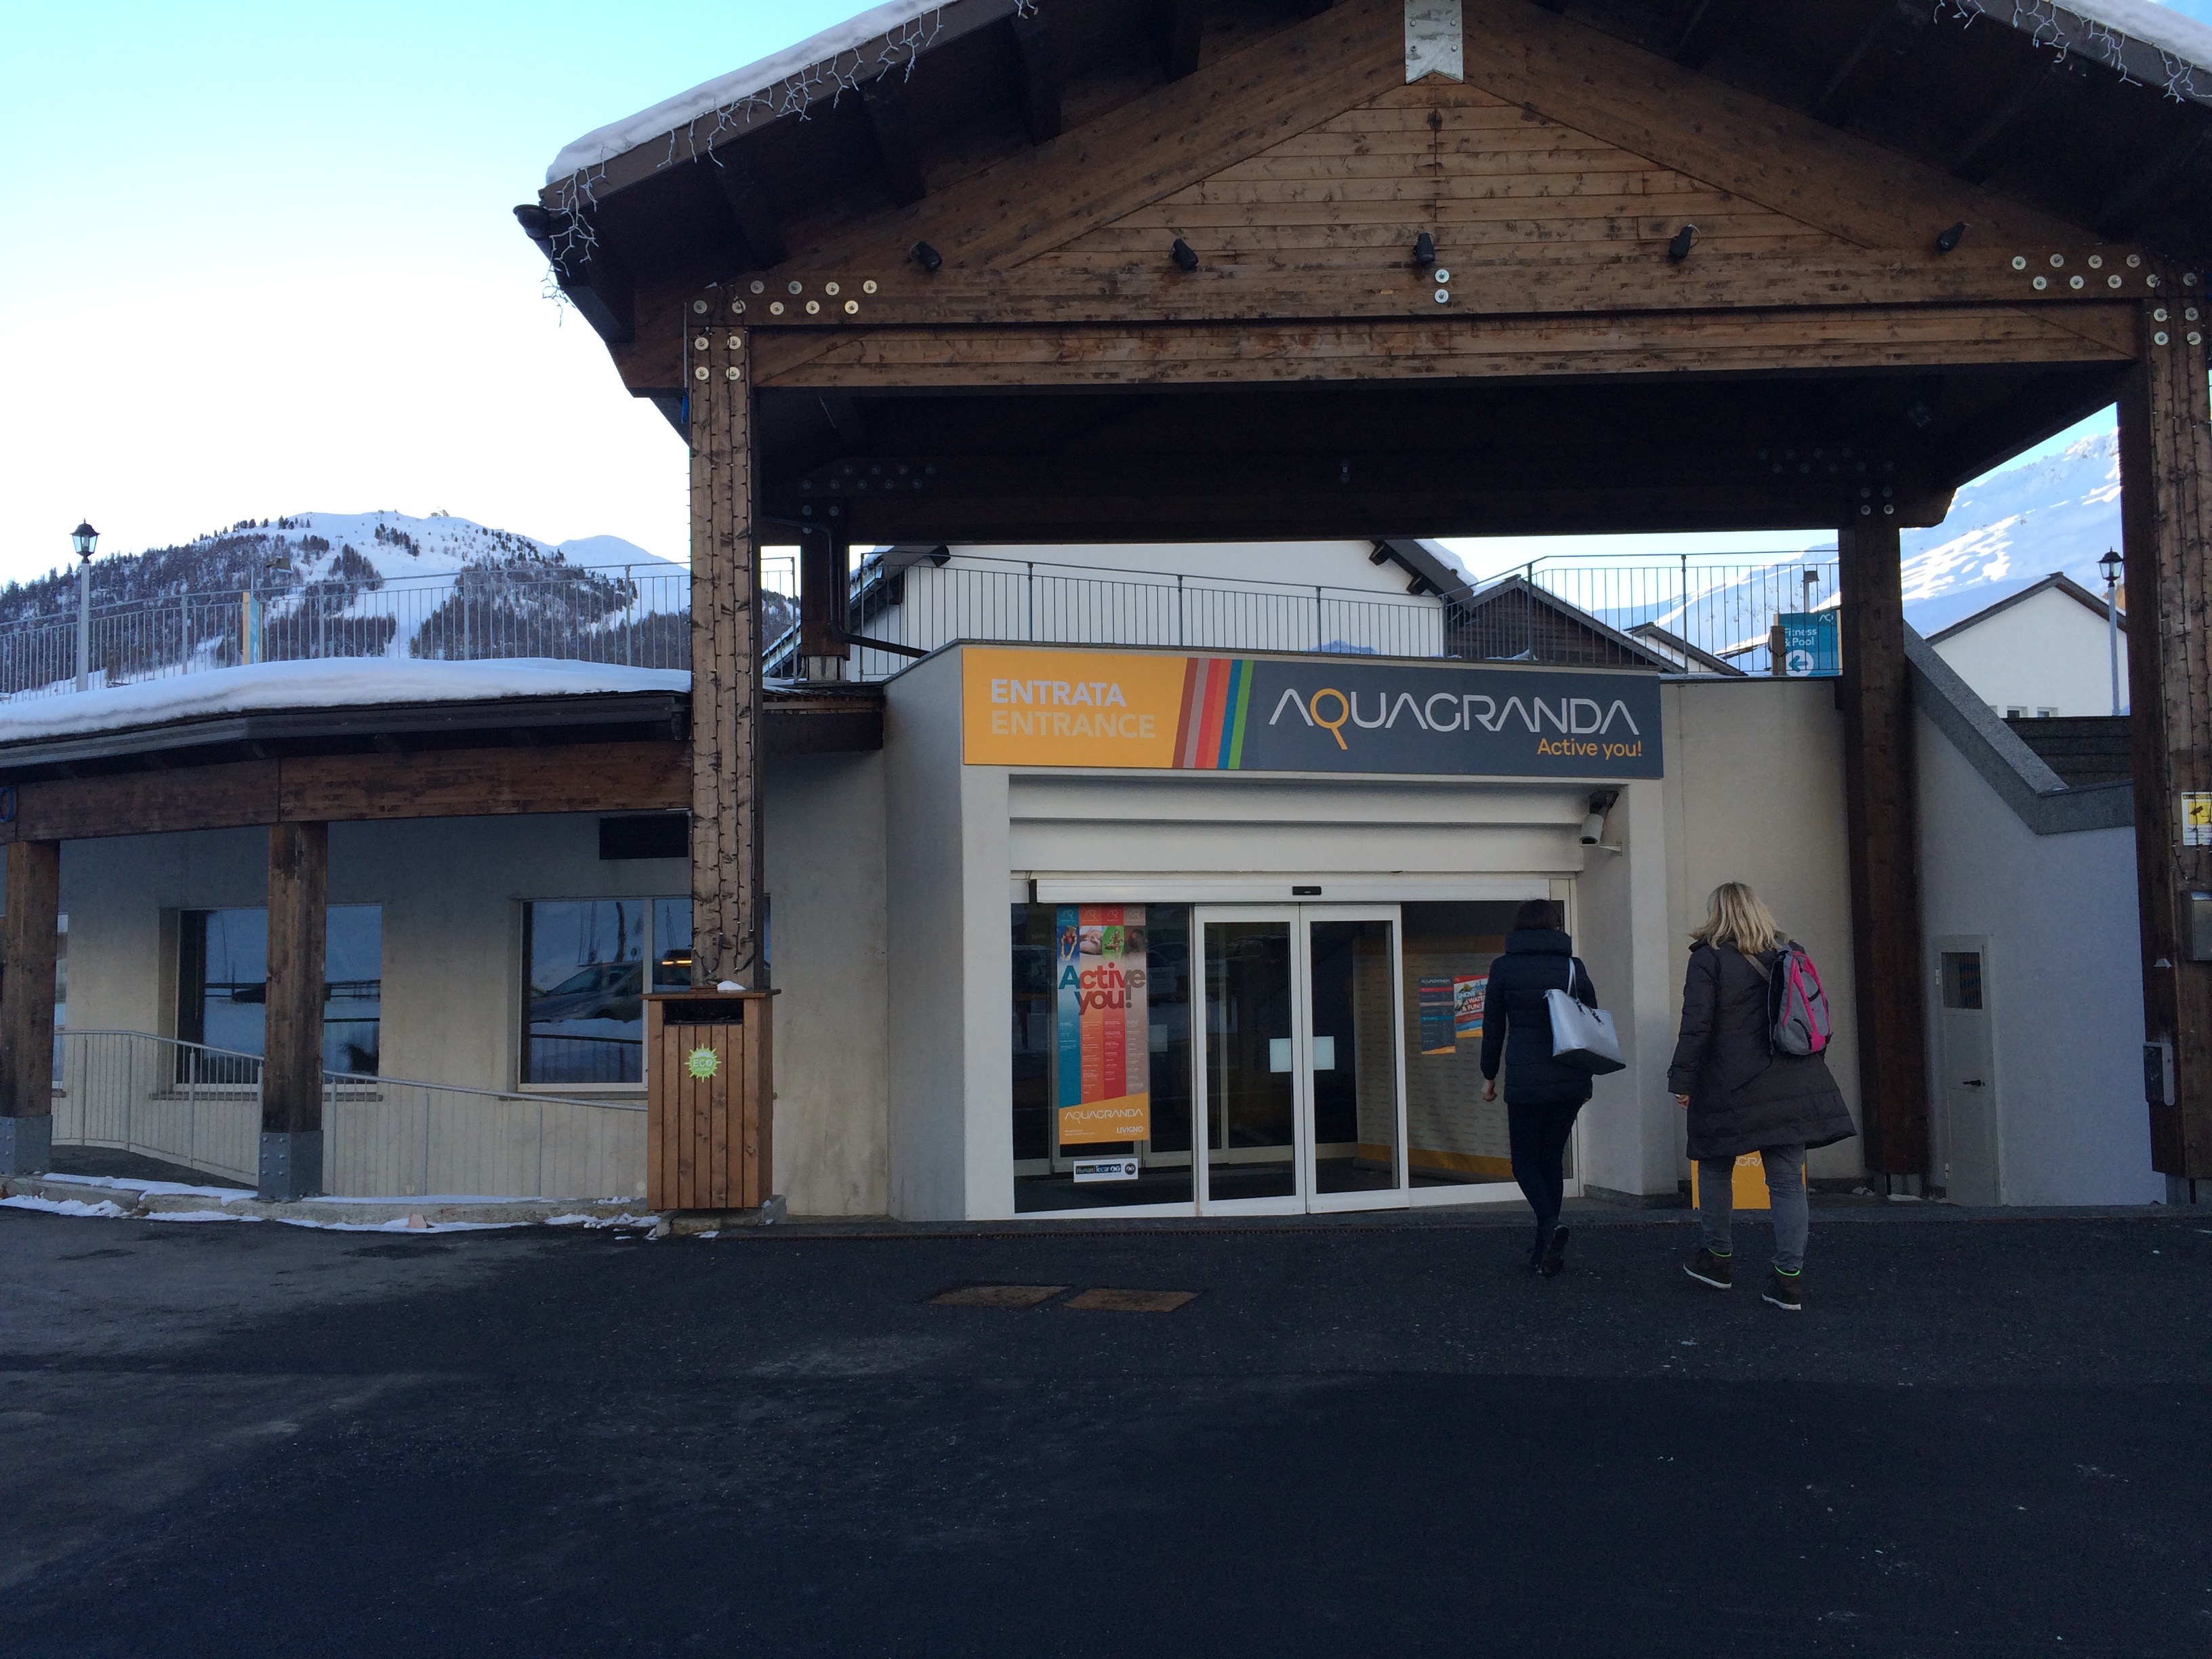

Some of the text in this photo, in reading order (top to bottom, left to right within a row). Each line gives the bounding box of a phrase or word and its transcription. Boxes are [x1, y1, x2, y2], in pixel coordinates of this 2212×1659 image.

[1792, 636, 1814, 647] Pool
[991, 678, 1127, 708] ENTRATA
[991, 710, 1156, 739] ENTRANCE
[1269, 688, 1639, 750] AQUAGRANDA
[1536, 738, 1642, 760] Active you!
[1058, 962, 1146, 989] Active
[1073, 984, 1132, 1015] you!
[1456, 991, 1476, 1000] SNOW
[693, 1059, 713, 1067] ECO
[1064, 1109, 1143, 1124] AQUAGRANDA
[1116, 1126, 1143, 1134] LIVIGNO
